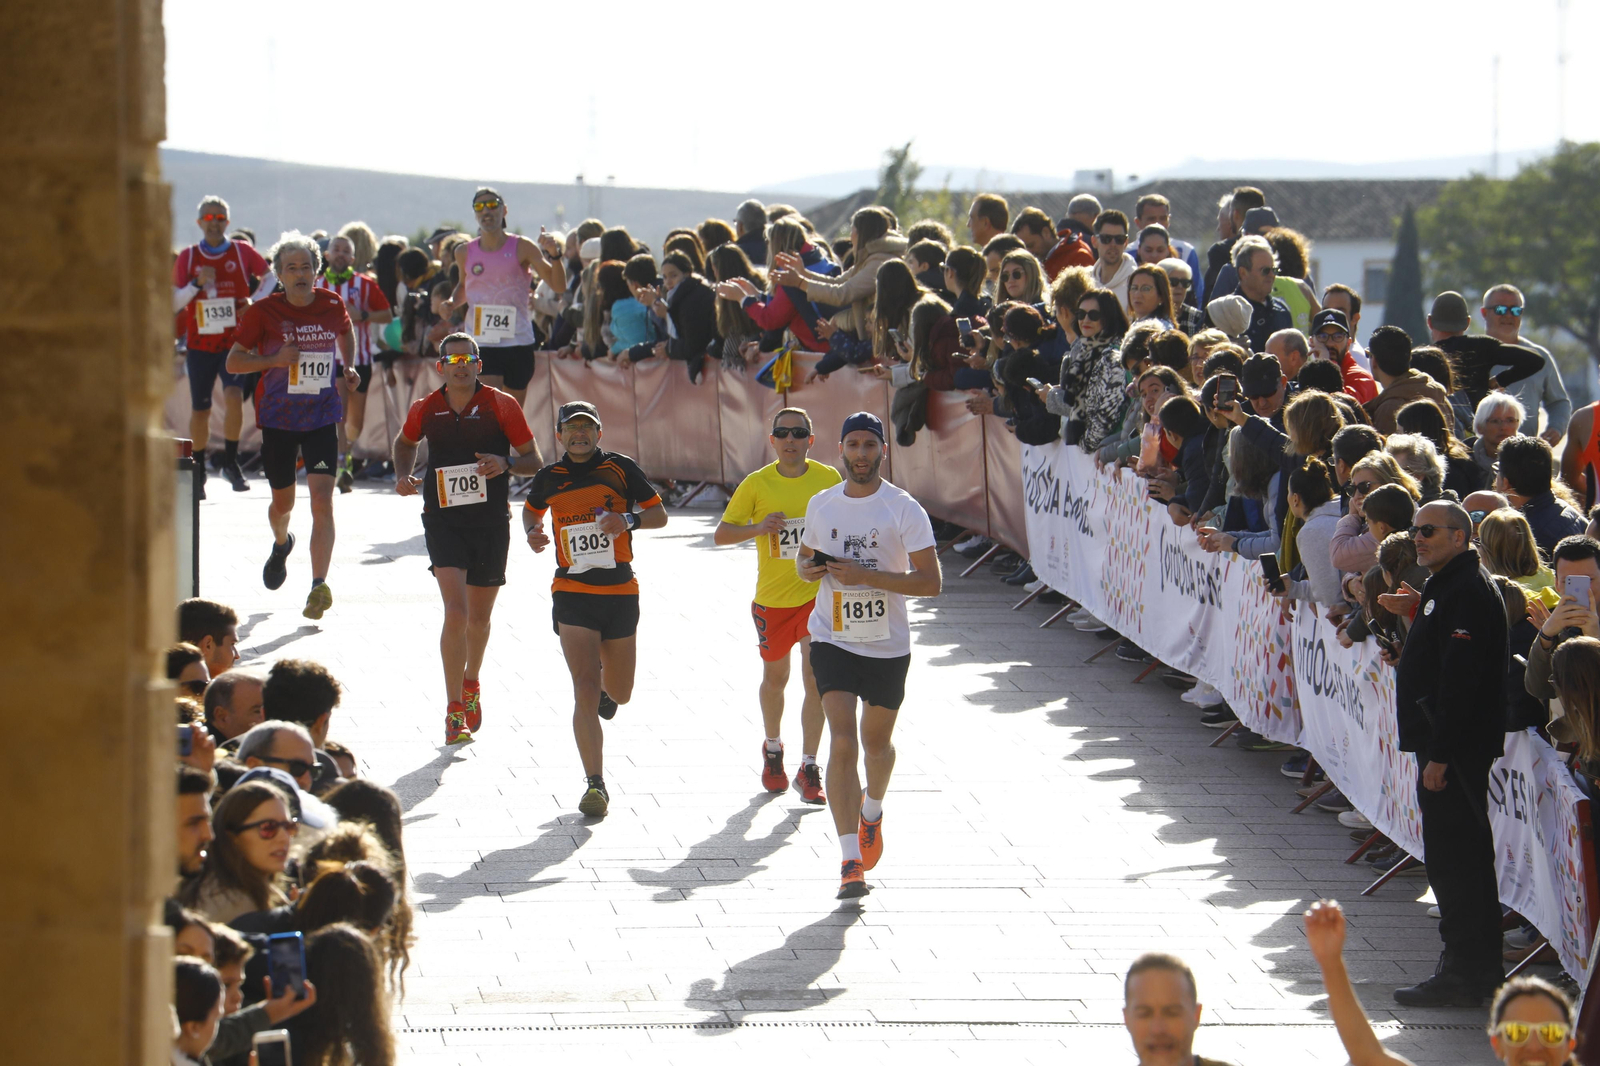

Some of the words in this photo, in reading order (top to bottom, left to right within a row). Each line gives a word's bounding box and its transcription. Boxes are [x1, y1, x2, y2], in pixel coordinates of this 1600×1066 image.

[204, 305, 233, 319] 1338
[295, 324, 324, 334] MEDIA
[485, 313, 510, 329] 784
[297, 329, 336, 342] MARATÓN
[299, 360, 331, 377] 1101
[448, 466, 469, 476] IMDECO
[448, 474, 480, 494] 708
[569, 532, 610, 553] 1303
[842, 598, 886, 620] 1813
[1510, 768, 1528, 825] ES
